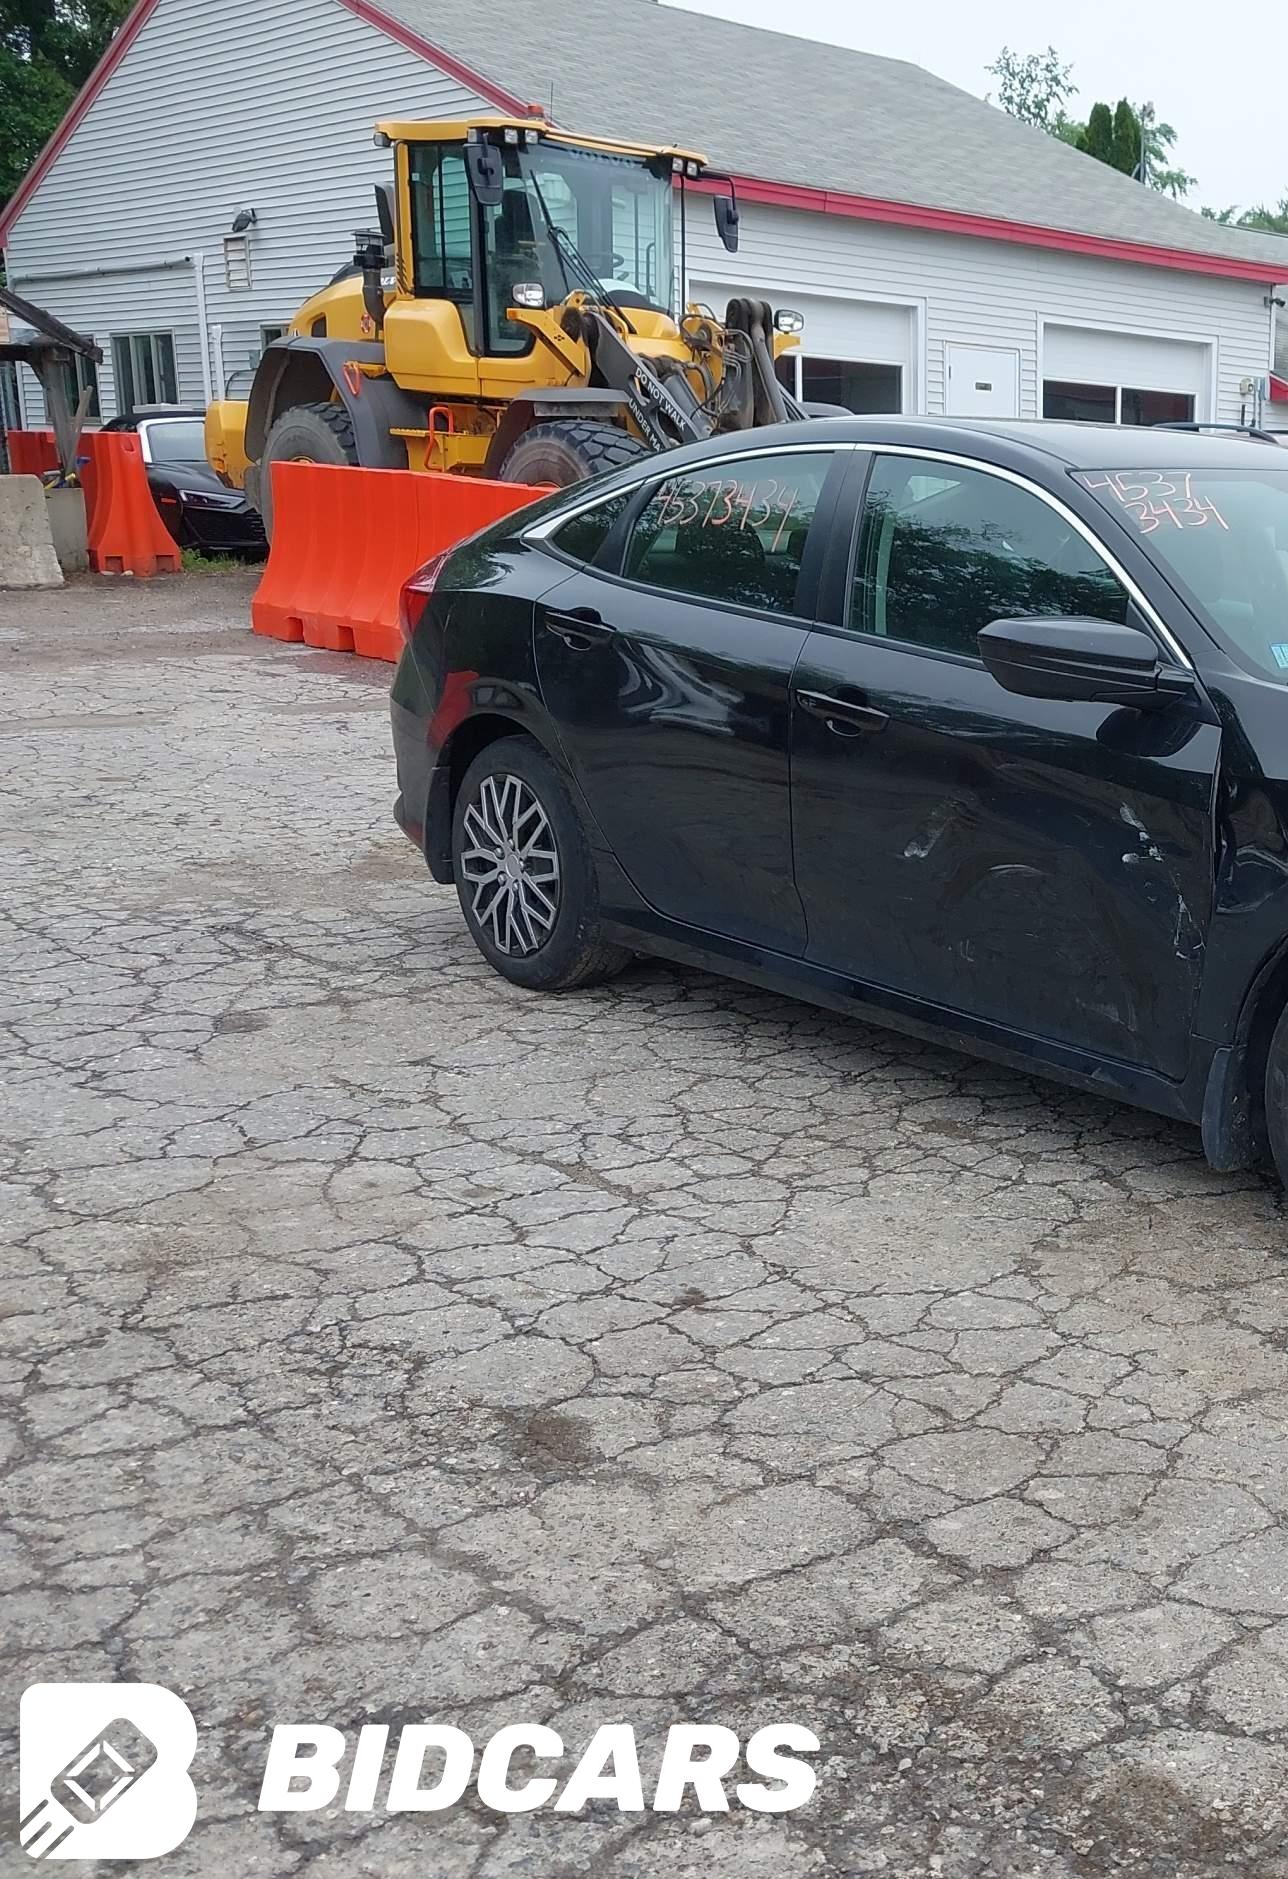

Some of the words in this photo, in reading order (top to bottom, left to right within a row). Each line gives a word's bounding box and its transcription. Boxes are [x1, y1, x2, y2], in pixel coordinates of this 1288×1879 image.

[628, 398, 651, 437] UNDER
[635, 367, 648, 385] DO
[647, 381, 665, 405] NOT
[664, 400, 686, 432] WALK
[1082, 472, 1192, 502] 4537
[651, 479, 799, 553] 45373434
[1123, 495, 1230, 534] 3434
